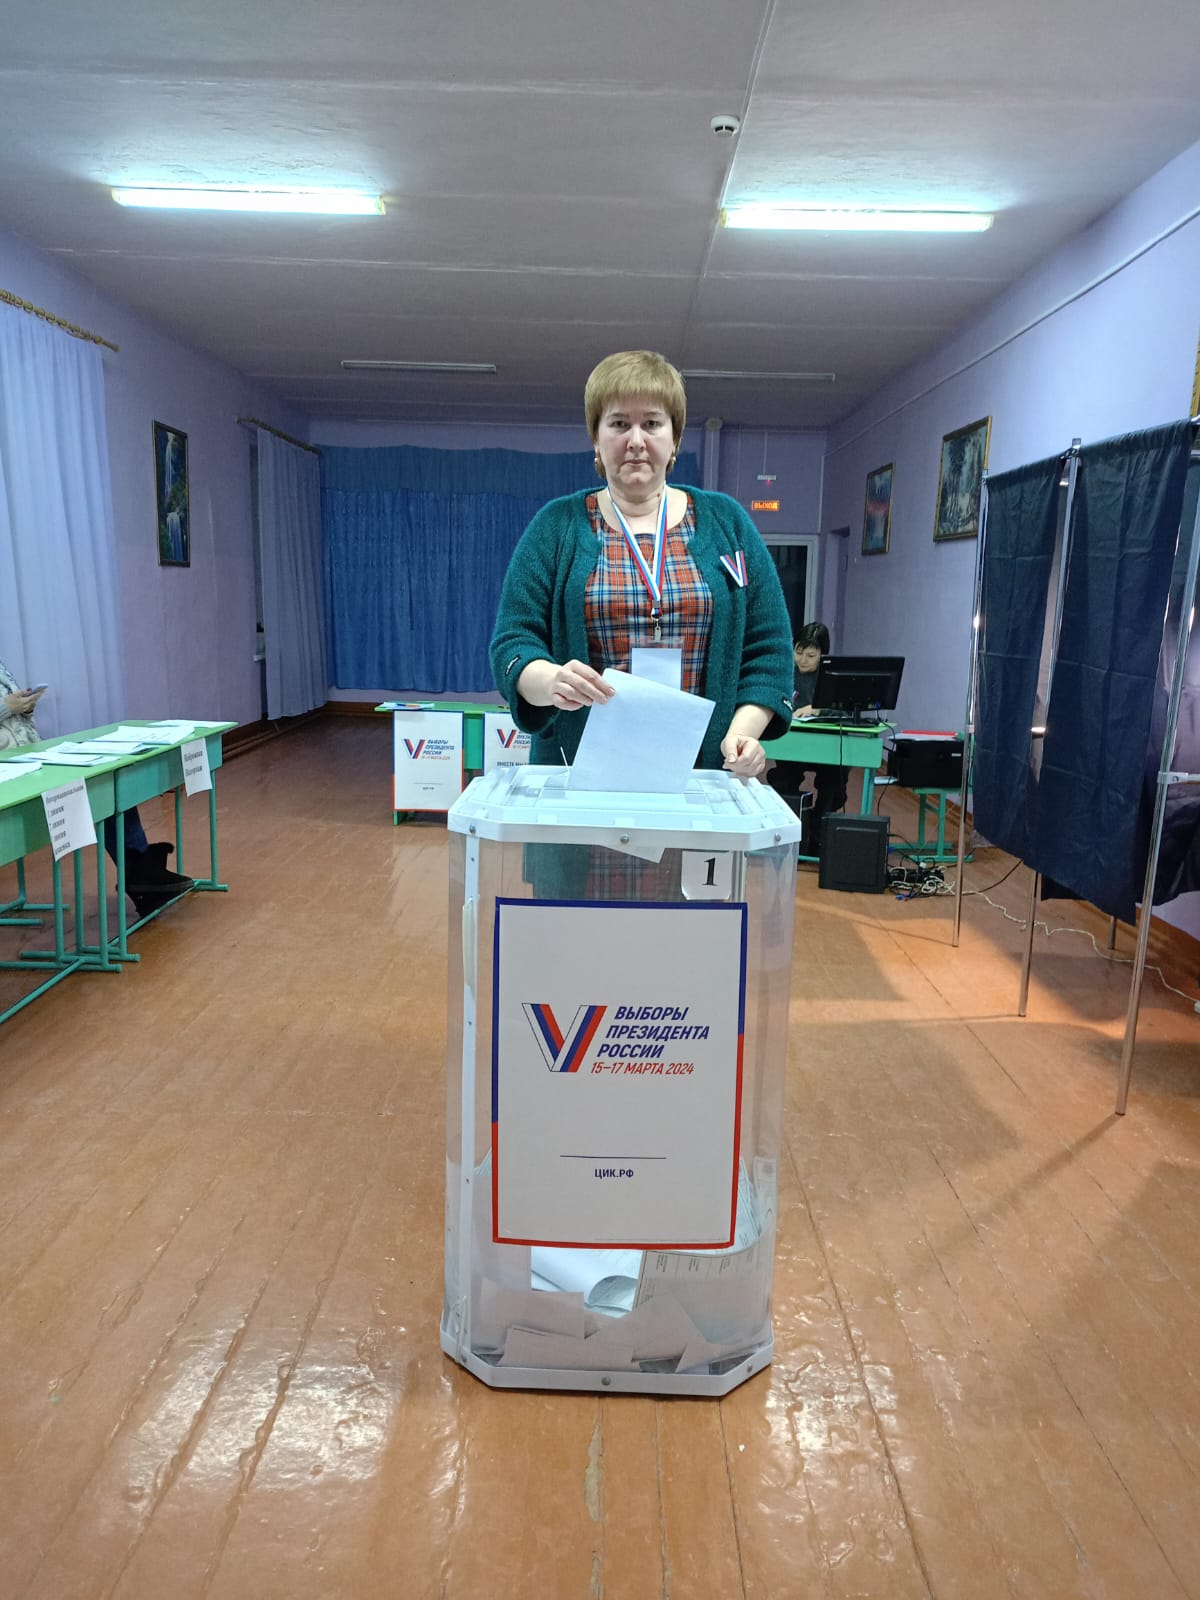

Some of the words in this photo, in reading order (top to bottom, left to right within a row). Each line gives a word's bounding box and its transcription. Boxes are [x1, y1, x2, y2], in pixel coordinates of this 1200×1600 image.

[701, 857, 718, 886] 1
[614, 1006, 689, 1021] ВЫБОРЫ
[605, 1025, 710, 1042] ПРЕЗИДЕНТА
[597, 1044, 665, 1058] РОССИИ
[624, 1062, 664, 1075] МАРТА
[665, 1063, 694, 1075] 2024
[594, 1169, 634, 1179] ЦИК.РФ
